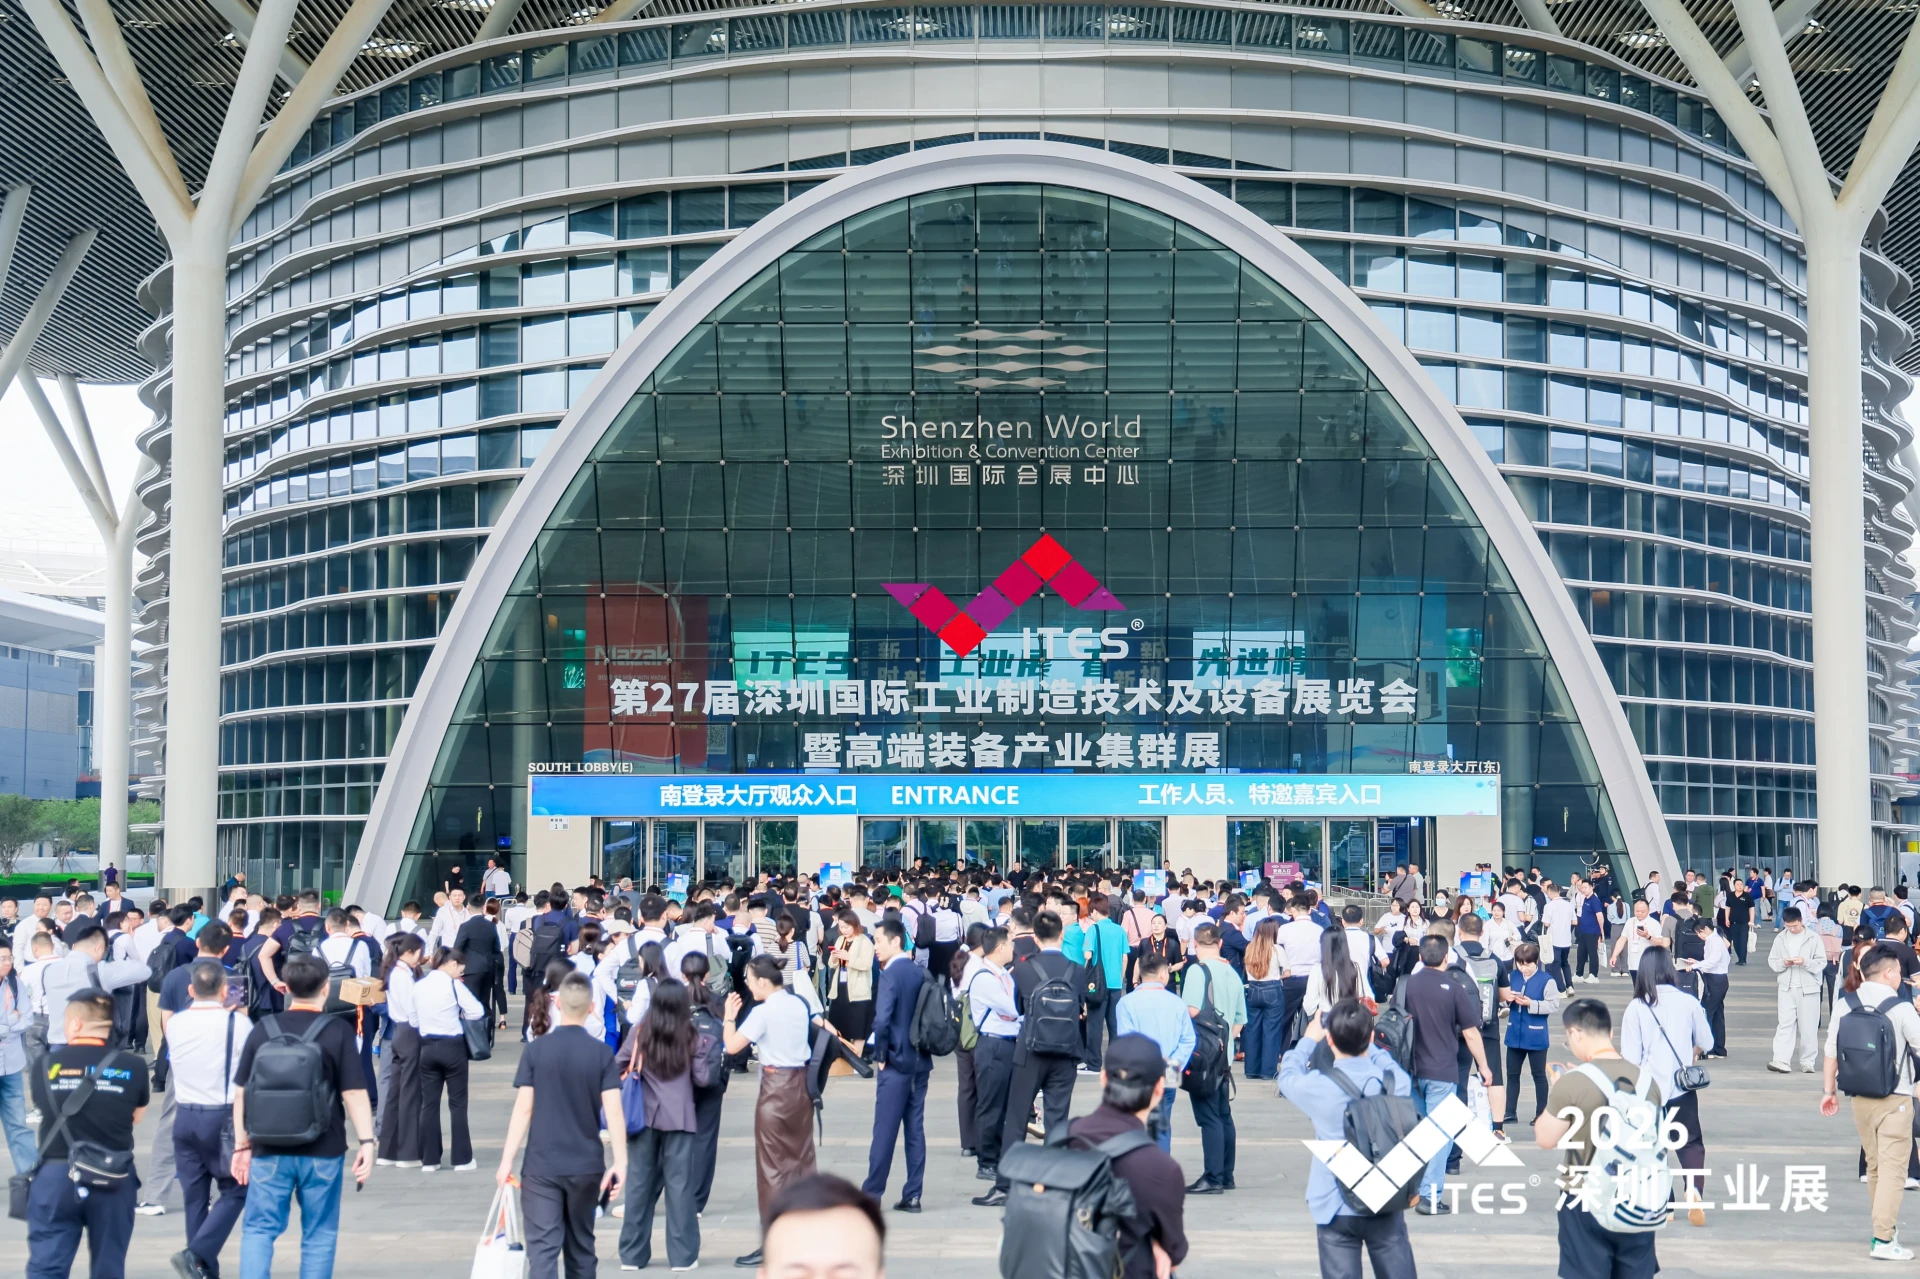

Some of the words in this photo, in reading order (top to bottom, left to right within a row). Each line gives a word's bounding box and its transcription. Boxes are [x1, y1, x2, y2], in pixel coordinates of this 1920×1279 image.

[881, 415, 1032, 439] Shenzhen
[1045, 415, 1141, 439] World
[881, 444, 963, 459] Exhibition
[968, 445, 982, 459] &
[985, 444, 1080, 459] Convention
[1084, 443, 1140, 459] Center
[882, 465, 1139, 486] 深圳国际会展中心
[594, 645, 672, 666] Mazak
[941, 648, 1052, 678] 工业展
[611, 678, 1418, 717] 第27届深圳国际工业制造技术及设备展览会
[803, 731, 1220, 769] 暨高端装备产业集群展
[527, 762, 572, 774] SOUTH
[577, 762, 634, 774] LOBBY(E)
[1408, 759, 1501, 775] 南登录大厅(东)
[660, 783, 857, 807] 南登录大厅观众入口
[891, 785, 1020, 805] ENTRANCE
[1138, 782, 1382, 807] 工作人员、特邀嘉宾入口
